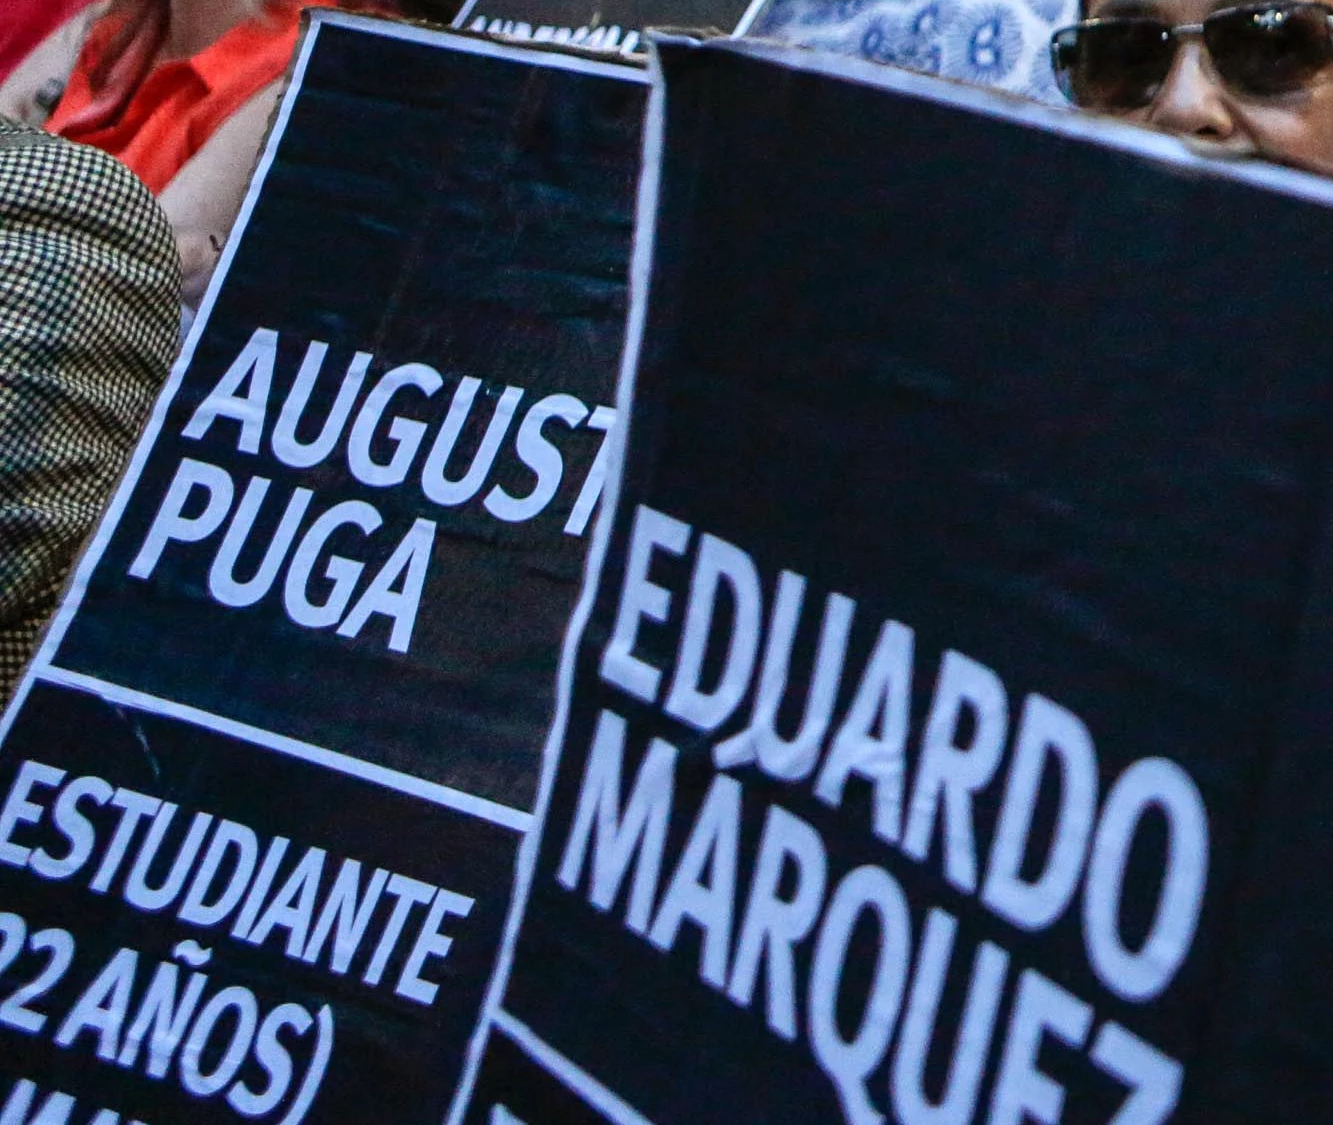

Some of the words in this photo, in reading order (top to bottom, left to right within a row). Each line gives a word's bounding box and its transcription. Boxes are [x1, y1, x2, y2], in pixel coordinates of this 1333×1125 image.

[127, 458, 438, 654] PUGA
[598, 504, 1211, 1003] EDUARDO
[0, 758, 476, 1006] ESTUDIANTE
[556, 707, 1186, 1125] MÁRQUEZ
[54, 938, 335, 1125] AÑOS)
